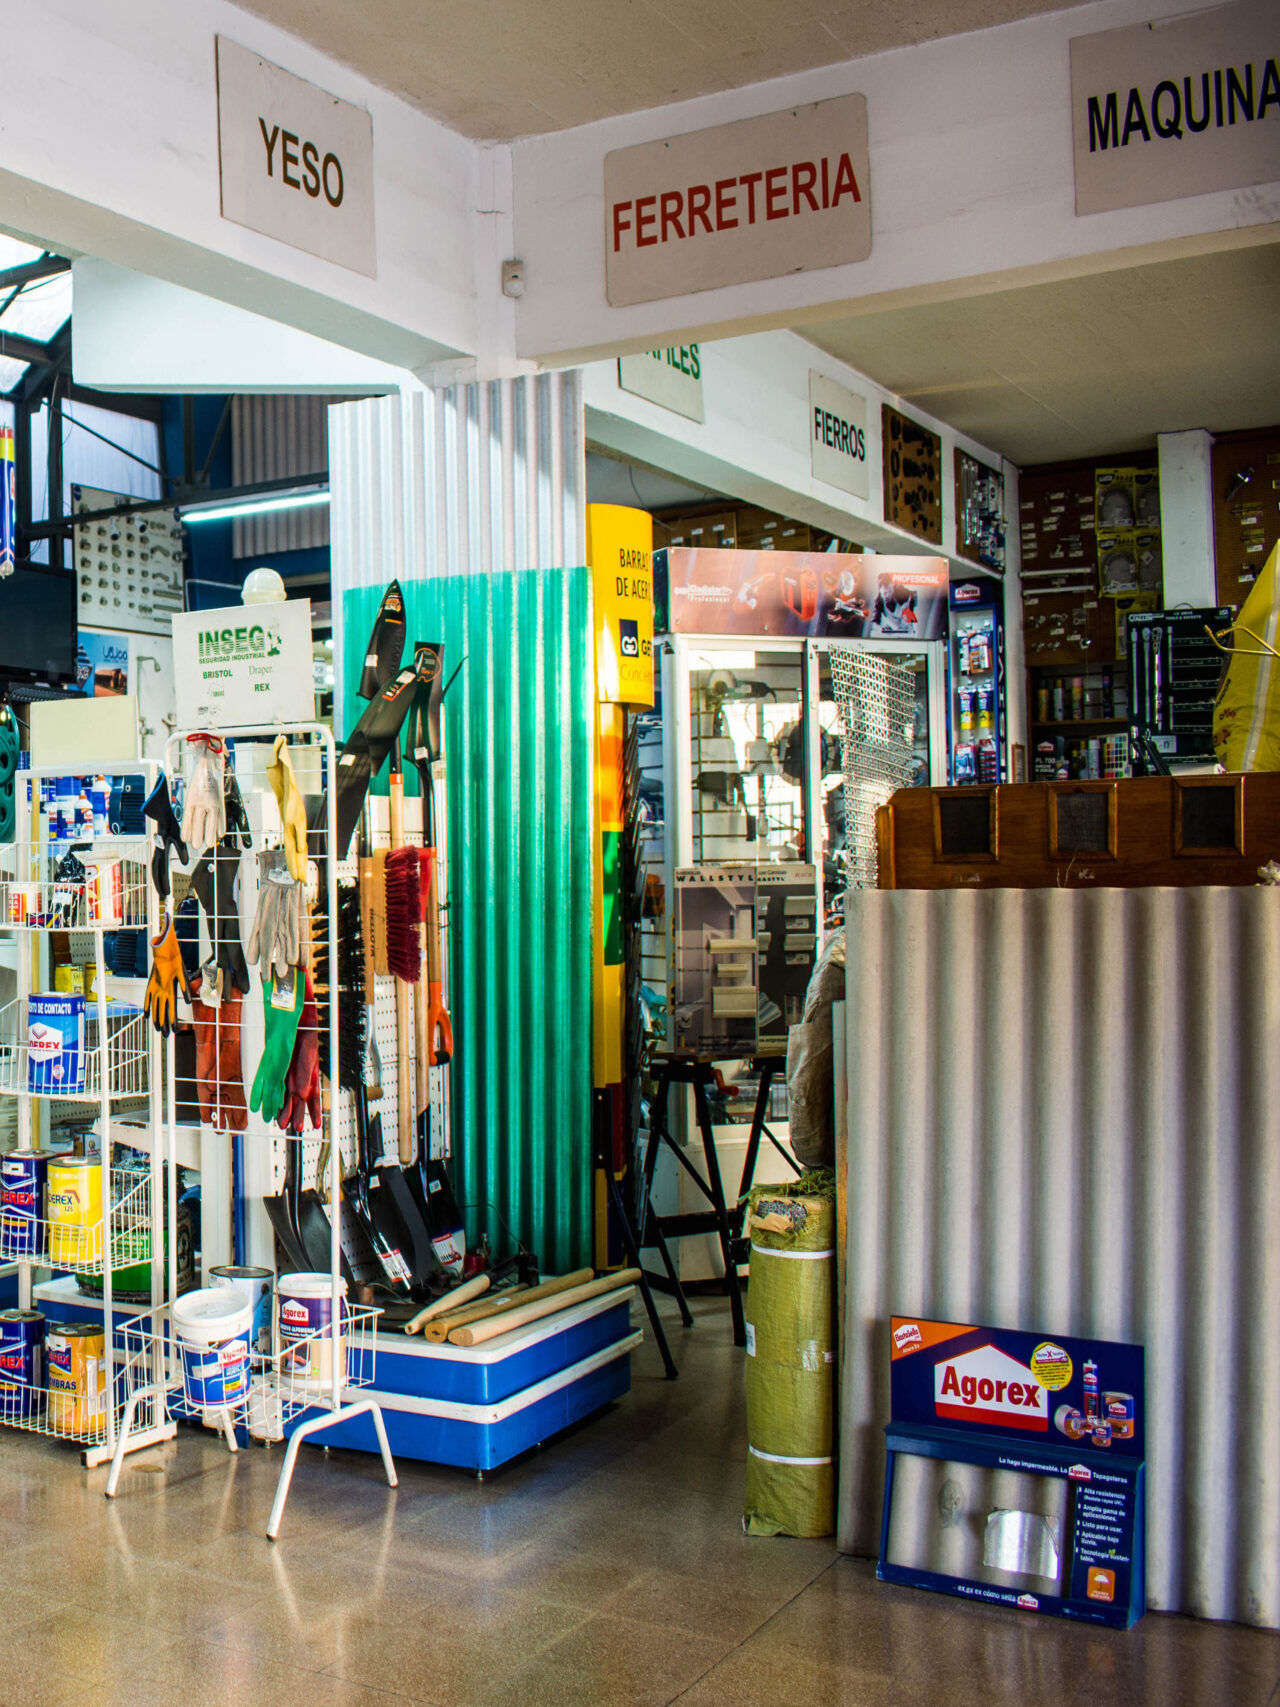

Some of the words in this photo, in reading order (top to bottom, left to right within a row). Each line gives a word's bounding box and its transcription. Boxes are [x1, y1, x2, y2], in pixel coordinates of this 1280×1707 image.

[258, 115, 345, 209] YESO
[611, 152, 862, 253] FERRETERIA
[813, 405, 866, 463] FIERROS
[619, 548, 650, 573] BARRAS
[891, 573, 941, 585] PROFESIONAL
[616, 577, 629, 598] DE
[198, 625, 265, 656] INSEG
[199, 655, 231, 664] SEGURIDAD
[231, 652, 266, 661] INDUSTRIAL
[202, 669, 233, 679] BRISTOL
[254, 683, 271, 692] REX
[38, 1002, 44, 1014] DE
[44, 1002, 72, 1014] CONTACTO
[282, 1306, 306, 1322] Agorex
[940, 1365, 1041, 1409] Agorex
[1006, 1458, 1021, 1468] hago
[1021, 1460, 1060, 1473] impermeable.
[1070, 1468, 1090, 1477] Agorex
[1092, 1471, 1128, 1484] Tapagoteras
[1095, 1489, 1126, 1500] resistencia
[1082, 1512, 1118, 1522] aplicaciones.
[1083, 1504, 1101, 1513] Amplia
[1102, 1508, 1118, 1516] gama
[1118, 1509, 1126, 1517] de
[1081, 1521, 1095, 1529] Listo
[1095, 1523, 1109, 1531] para
[1109, 1526, 1123, 1534] usar.
[1080, 1531, 1107, 1541] Aplicable
[1106, 1534, 1120, 1544] bajo
[1000, 1592, 1017, 1602] sella
